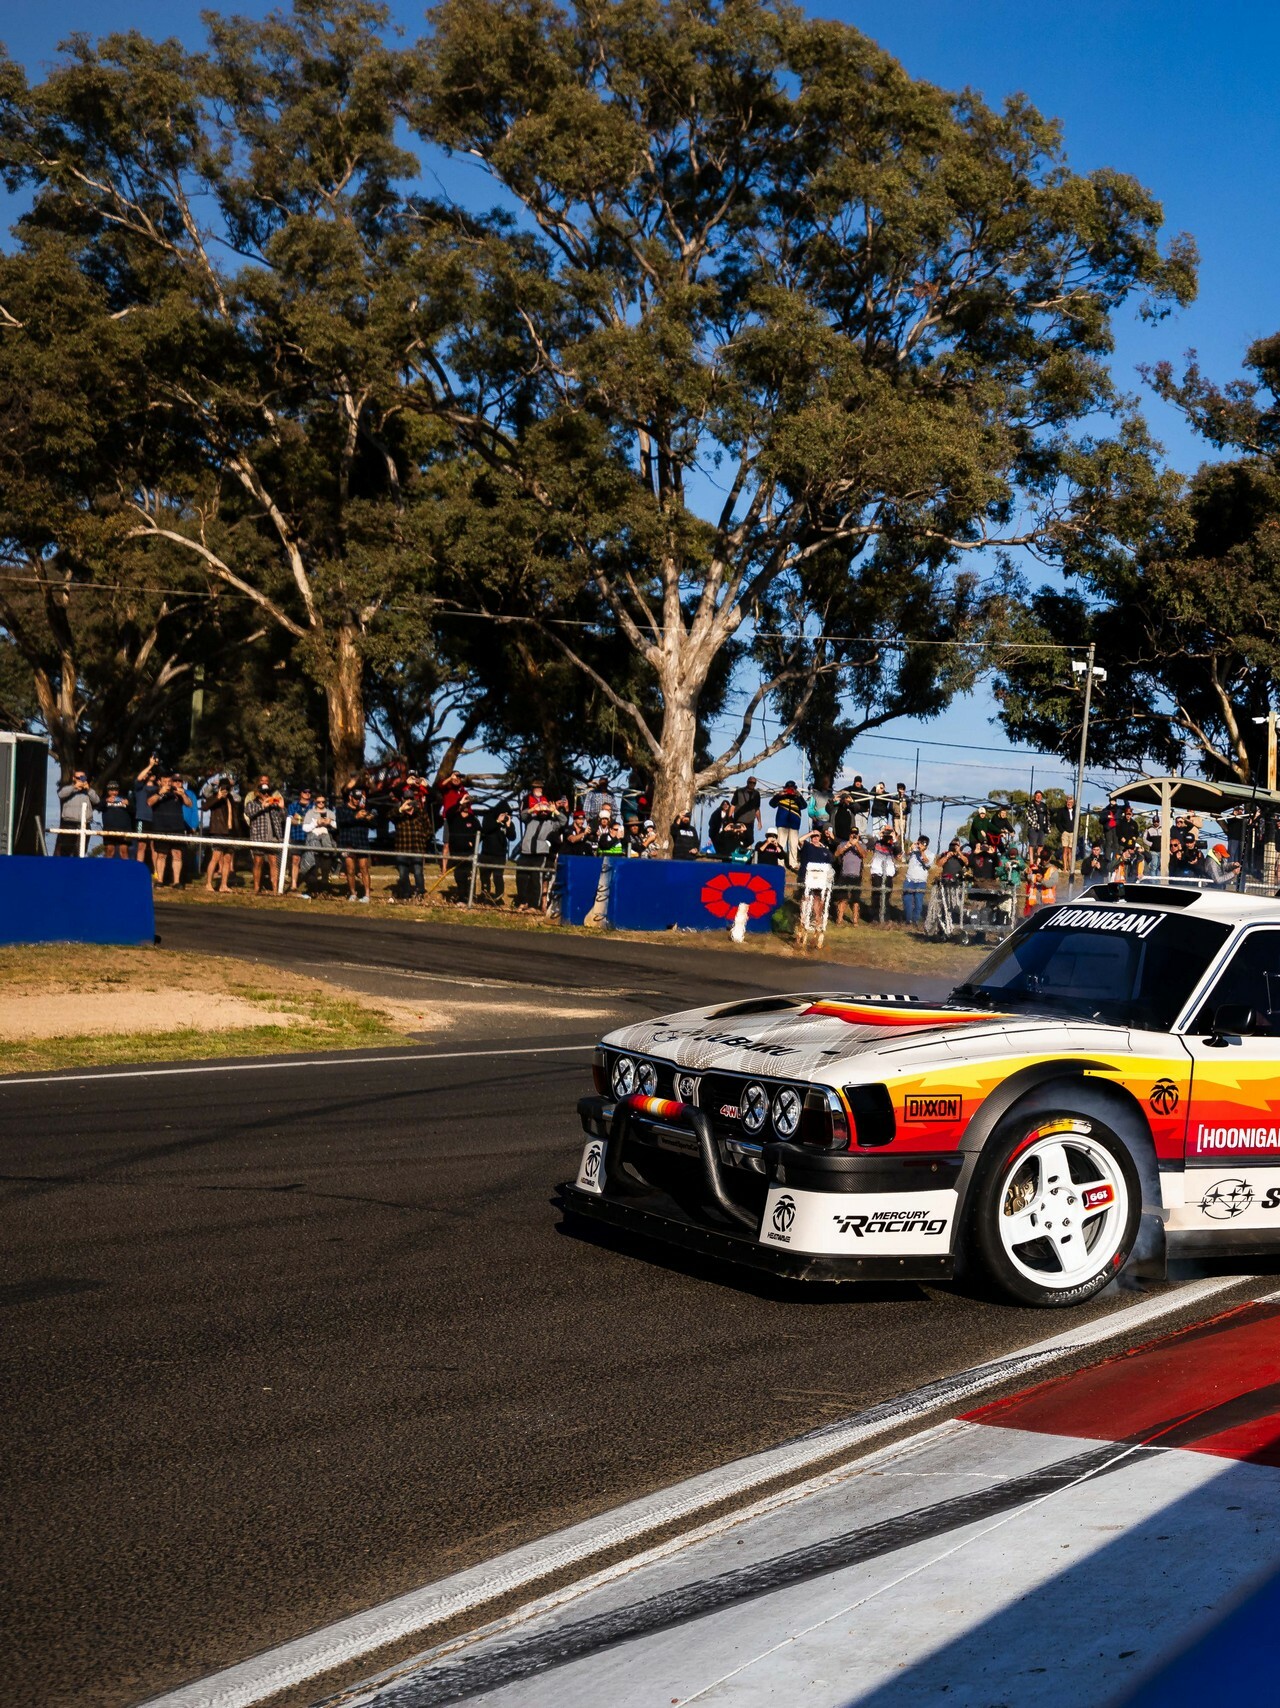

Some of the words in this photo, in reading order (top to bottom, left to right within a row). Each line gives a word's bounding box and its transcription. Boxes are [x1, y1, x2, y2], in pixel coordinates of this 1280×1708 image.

[909, 1099, 957, 1117] DIXXON
[1090, 1189, 1109, 1202] 199
[871, 1210, 931, 1220] MERCURY
[838, 1215, 948, 1238] Racing
